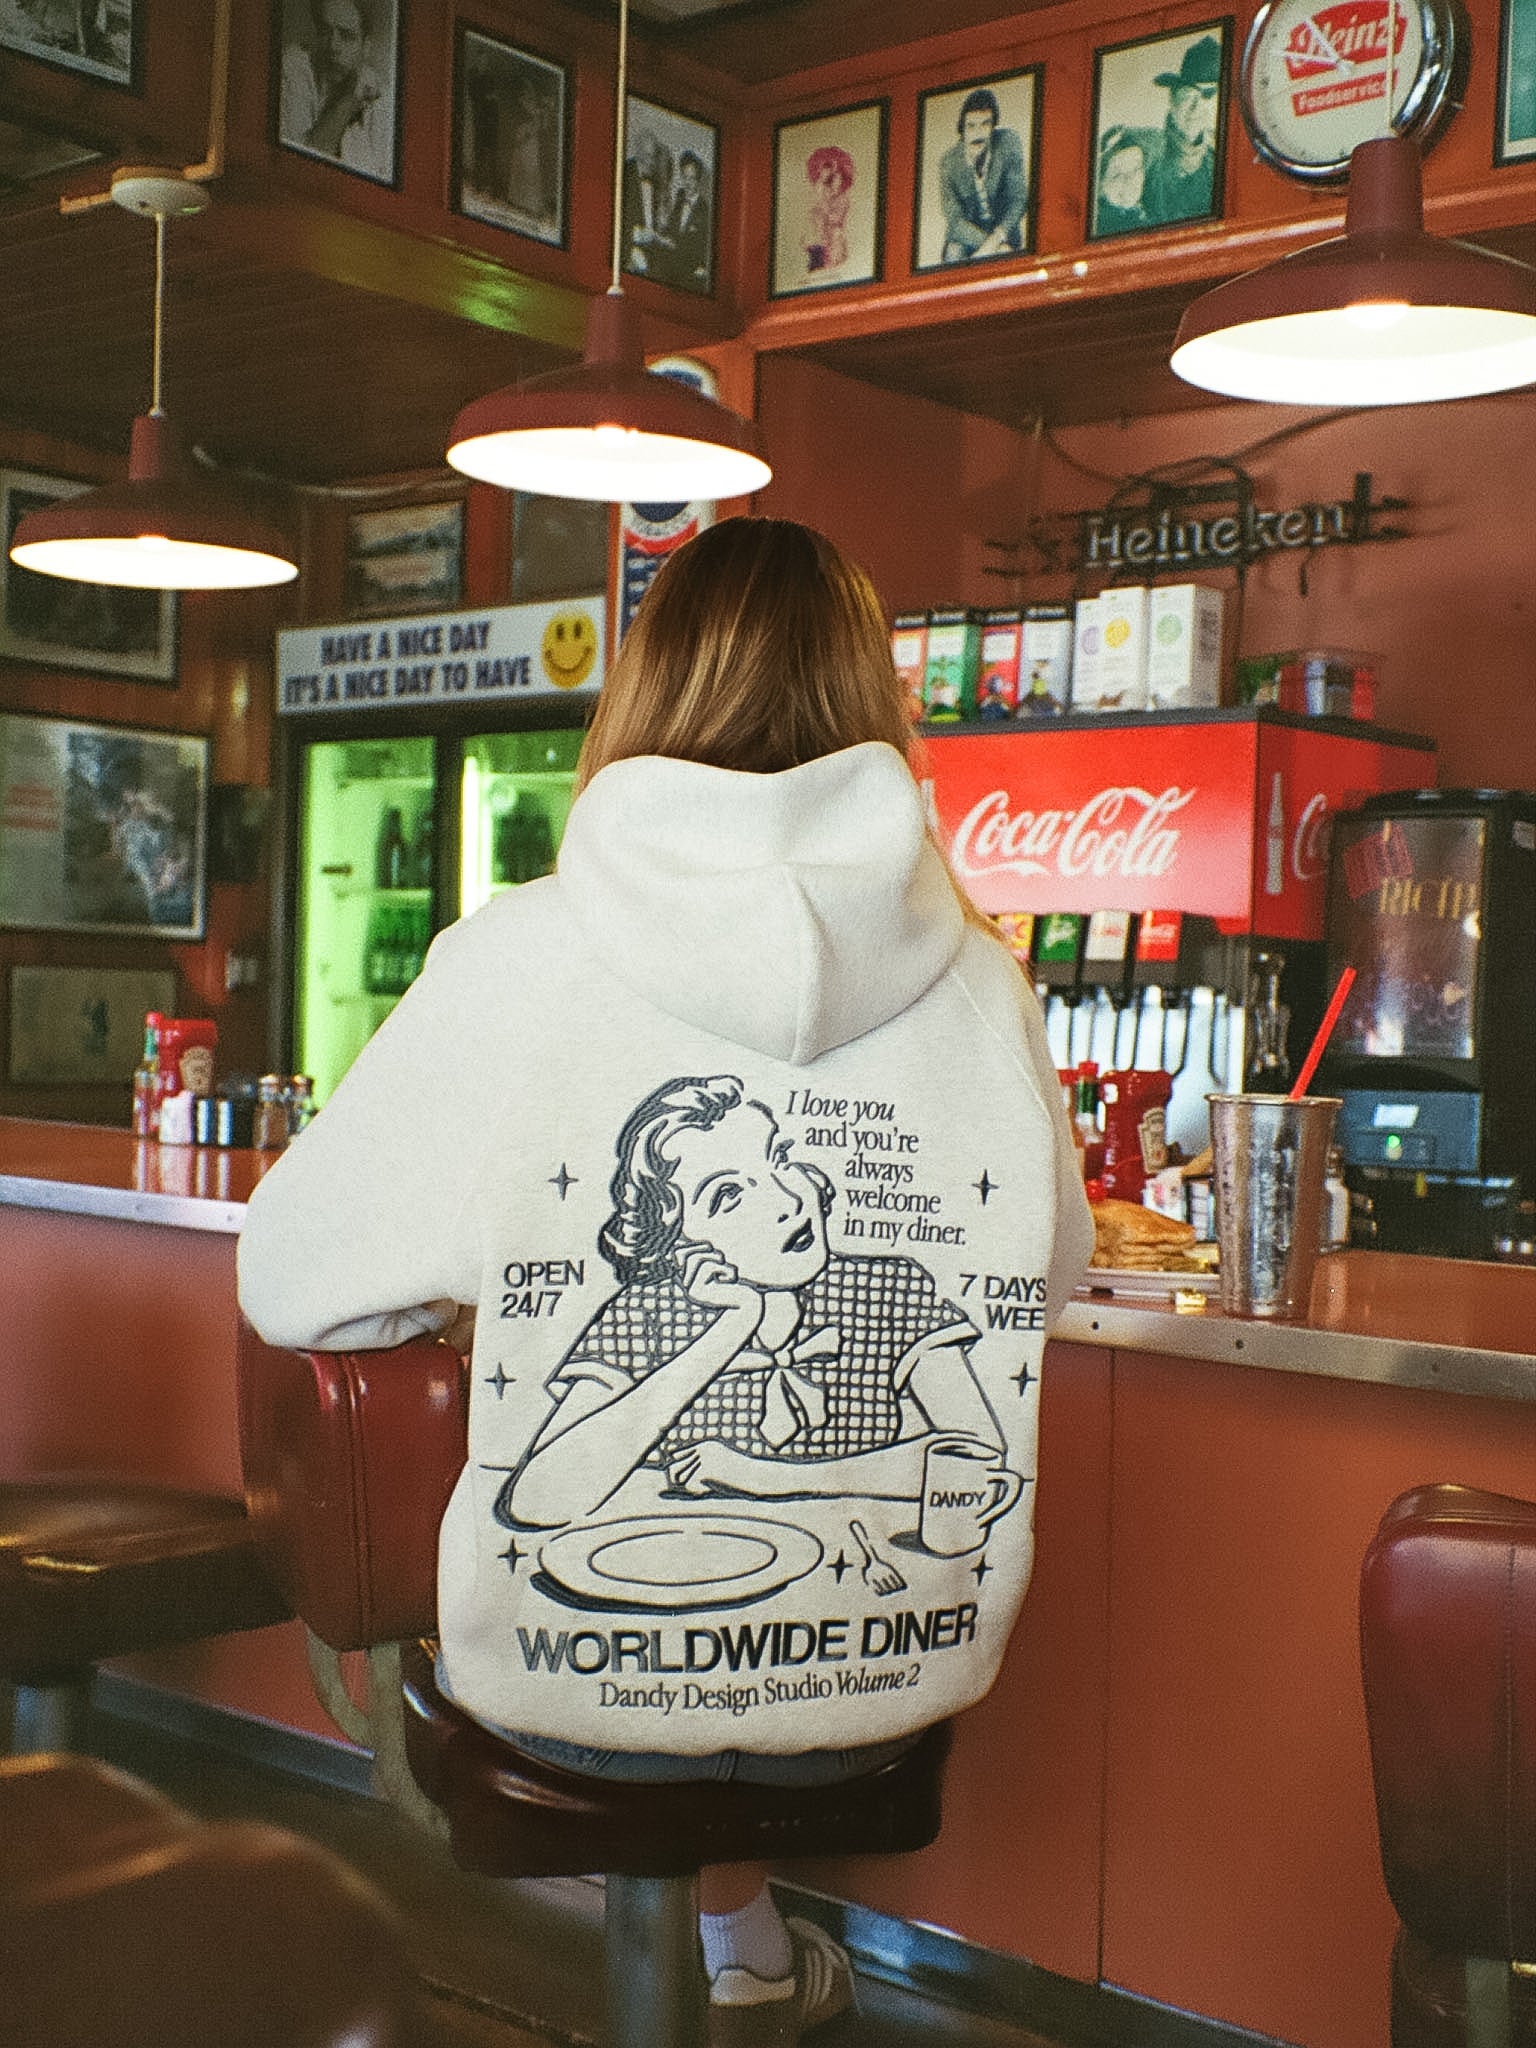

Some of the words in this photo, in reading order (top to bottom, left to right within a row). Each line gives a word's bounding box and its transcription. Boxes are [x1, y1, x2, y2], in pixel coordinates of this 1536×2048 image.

[1086, 502, 1350, 568] Heineken
[321, 632, 371, 666] HAVE
[377, 631, 390, 659] A
[397, 626, 443, 656] NICE
[450, 621, 491, 651] DAY
[284, 674, 321, 704] IT'S
[325, 672, 338, 700] A
[344, 669, 388, 698] NICE
[395, 665, 433, 694] DAY
[440, 661, 468, 691] TO
[474, 656, 530, 687] HAVE
[786, 1090, 798, 1115] I
[802, 1089, 848, 1118] love
[849, 1100, 895, 1126] you
[805, 1122, 847, 1148] and
[853, 1127, 919, 1156] you're
[845, 1153, 914, 1189] always
[846, 1185, 941, 1214] welcome
[844, 1212, 864, 1237] in
[870, 1220, 902, 1247] my
[907, 1216, 966, 1246] diner.
[504, 1260, 584, 1288] OPEN
[960, 1273, 978, 1297] 7
[984, 1275, 1047, 1303] DAYS
[501, 1291, 563, 1319] 24/7
[985, 1303, 1046, 1331] WEE
[930, 1491, 987, 1508] DANDY
[516, 1619, 849, 1676] WORLDWIDE
[861, 1601, 979, 1659] DINER
[600, 1681, 678, 1715] Dandy
[683, 1683, 761, 1717] Design
[764, 1673, 833, 1704] Studio
[836, 1667, 905, 1694] Volume
[906, 1662, 922, 1689] 2
